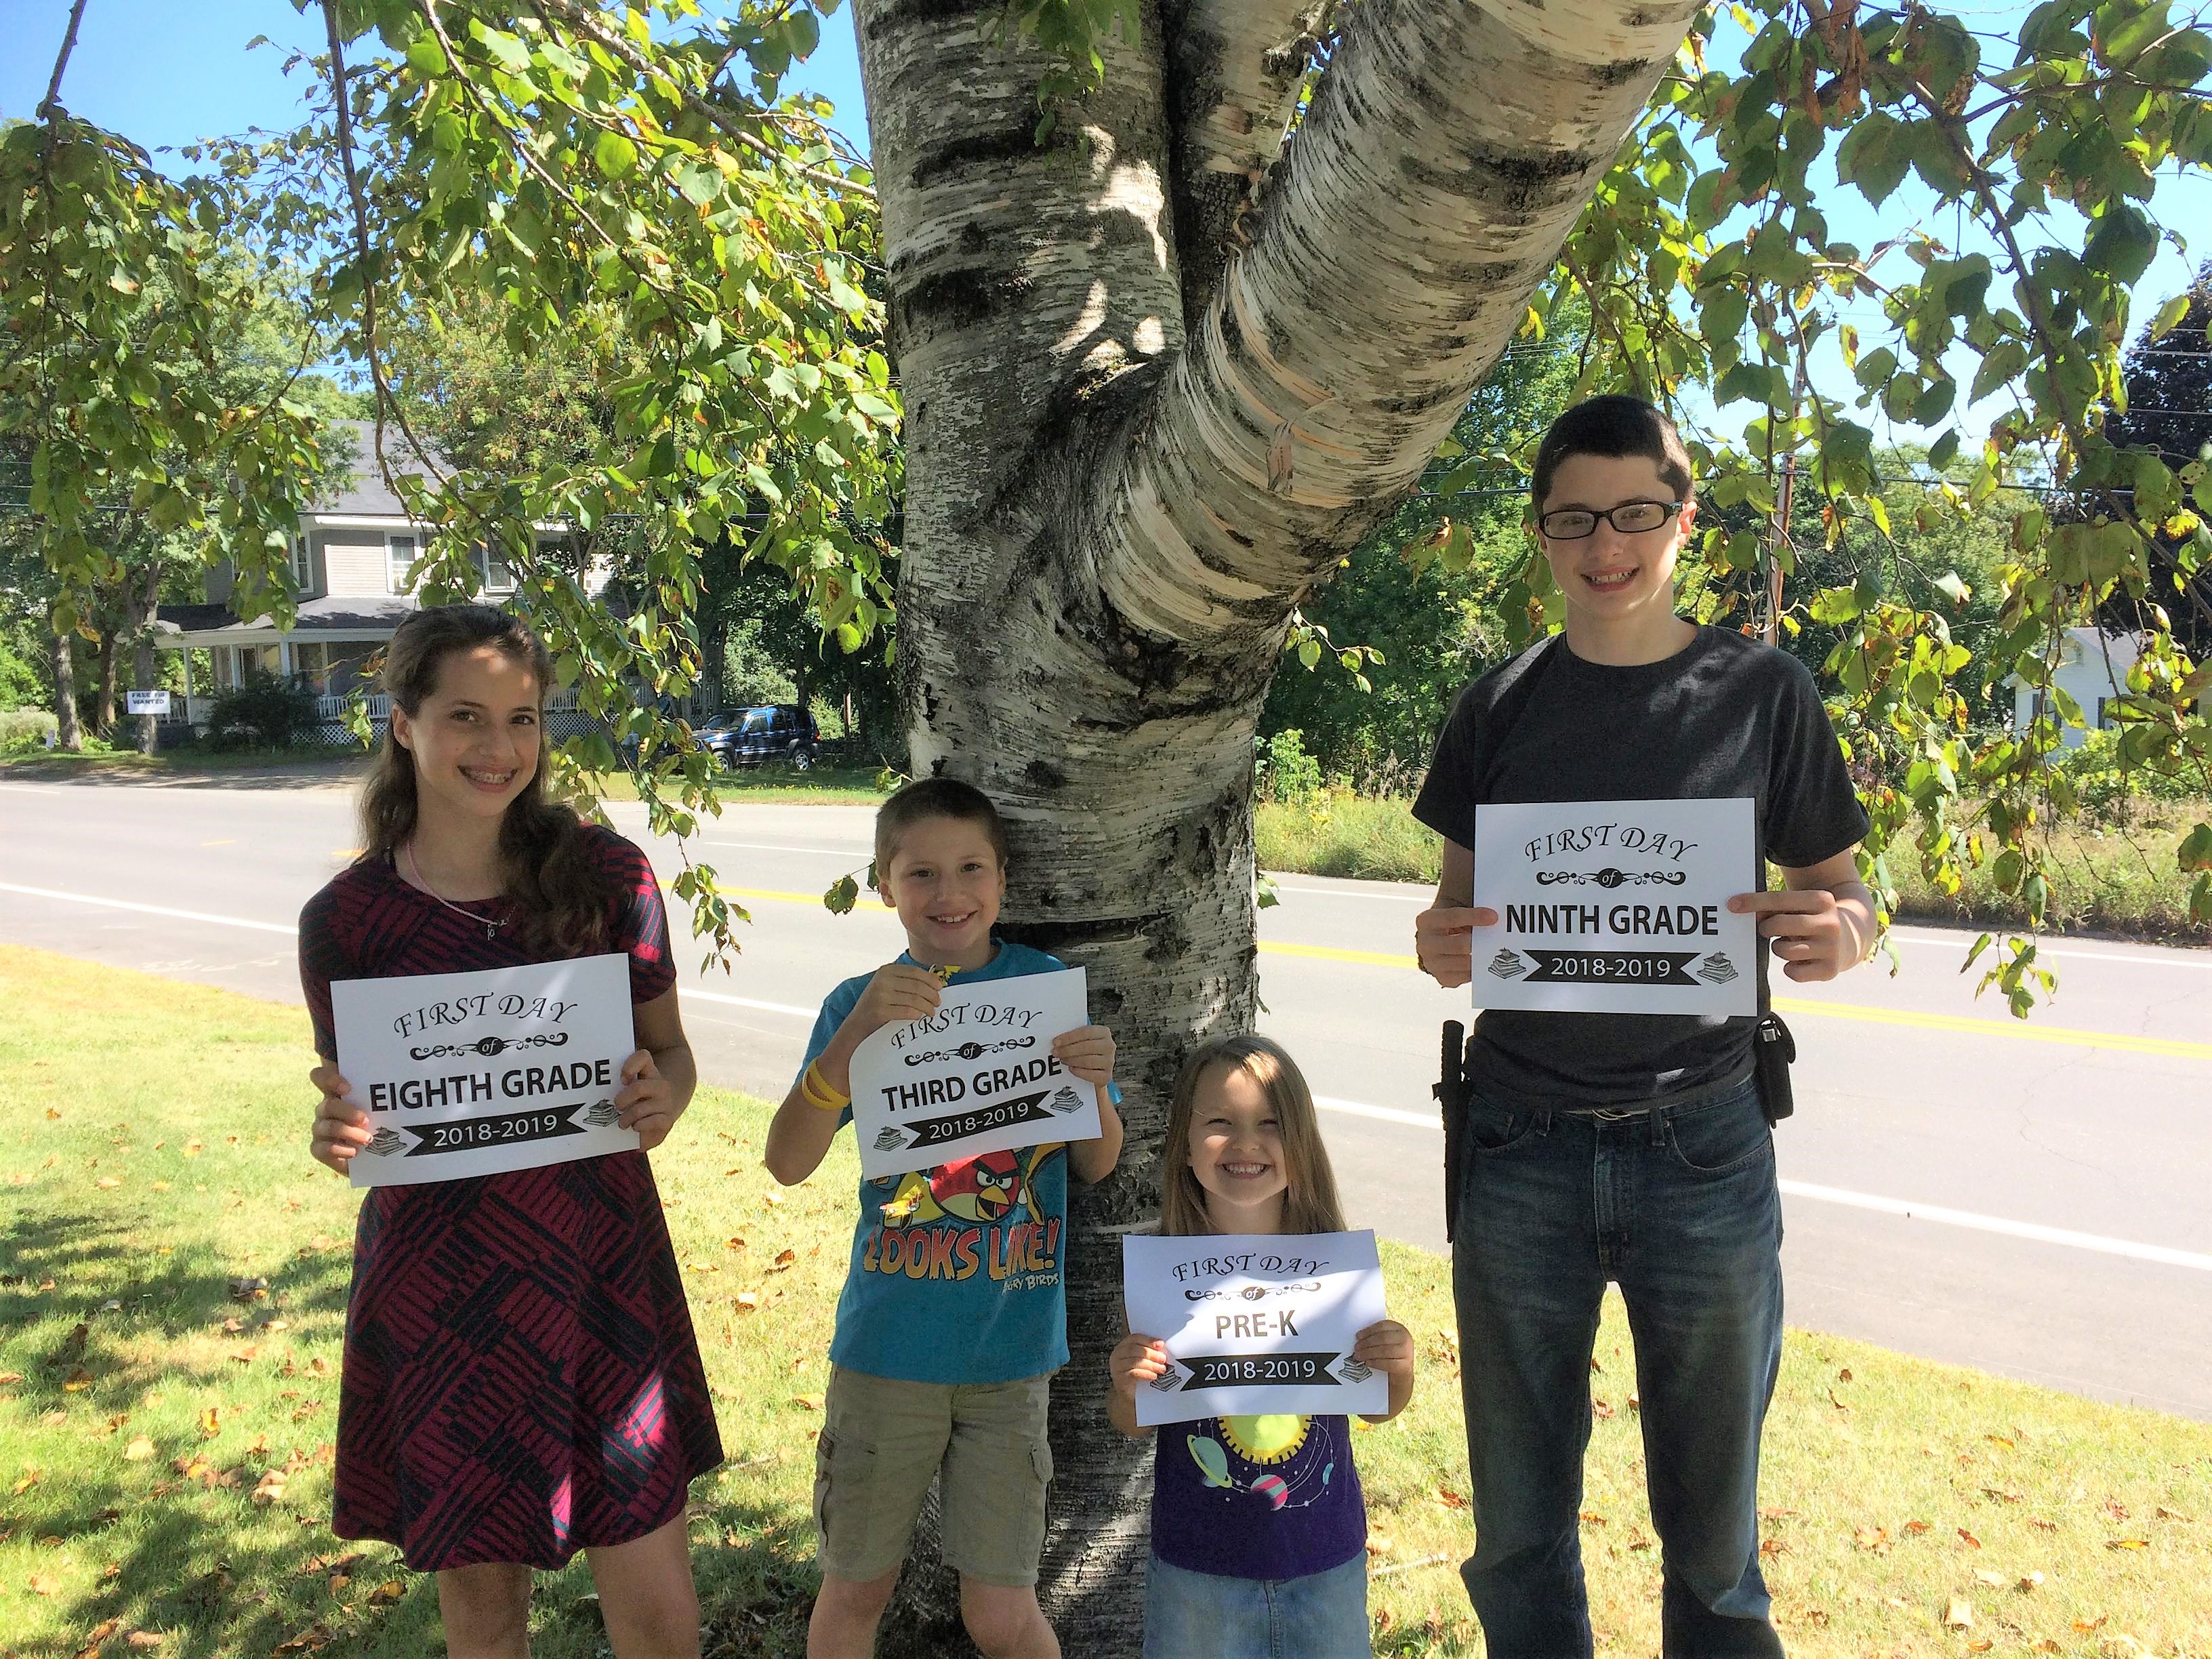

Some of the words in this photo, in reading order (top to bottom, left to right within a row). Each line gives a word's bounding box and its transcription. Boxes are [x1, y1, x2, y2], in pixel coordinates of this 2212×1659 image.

[1525, 823, 1618, 862] FIRST
[1620, 827, 1698, 862] DAY
[1601, 871, 1617, 886] of
[1506, 904, 1599, 934] NINTH
[1609, 905, 1719, 935] GRADE
[1551, 958, 1671, 978] 2018-2019
[394, 991, 494, 1038] FIRST
[498, 994, 577, 1023] DAY
[890, 1002, 970, 1050] FIRST
[975, 1004, 1043, 1029] DAY
[481, 1039, 497, 1054] of
[963, 1044, 977, 1057] of
[369, 1073, 492, 1112] EIGHTH
[501, 1059, 611, 1098] GRADE
[882, 1077, 966, 1111] THIRD
[973, 1054, 1062, 1096] GRADE
[434, 1115, 558, 1147] 2018-2019
[928, 1102, 1029, 1139] 2018-2019
[863, 1224, 981, 1280] LOOKS
[988, 1218, 1061, 1280] LIKE!
[1025, 1273, 1060, 1290] BIRDS
[1172, 1253, 1256, 1283] FIRST
[1259, 1255, 1330, 1276] DAY
[1246, 1287, 1259, 1300] of
[1216, 1309, 1298, 1339] PRE-K
[1204, 1359, 1315, 1381] 2018-2019
